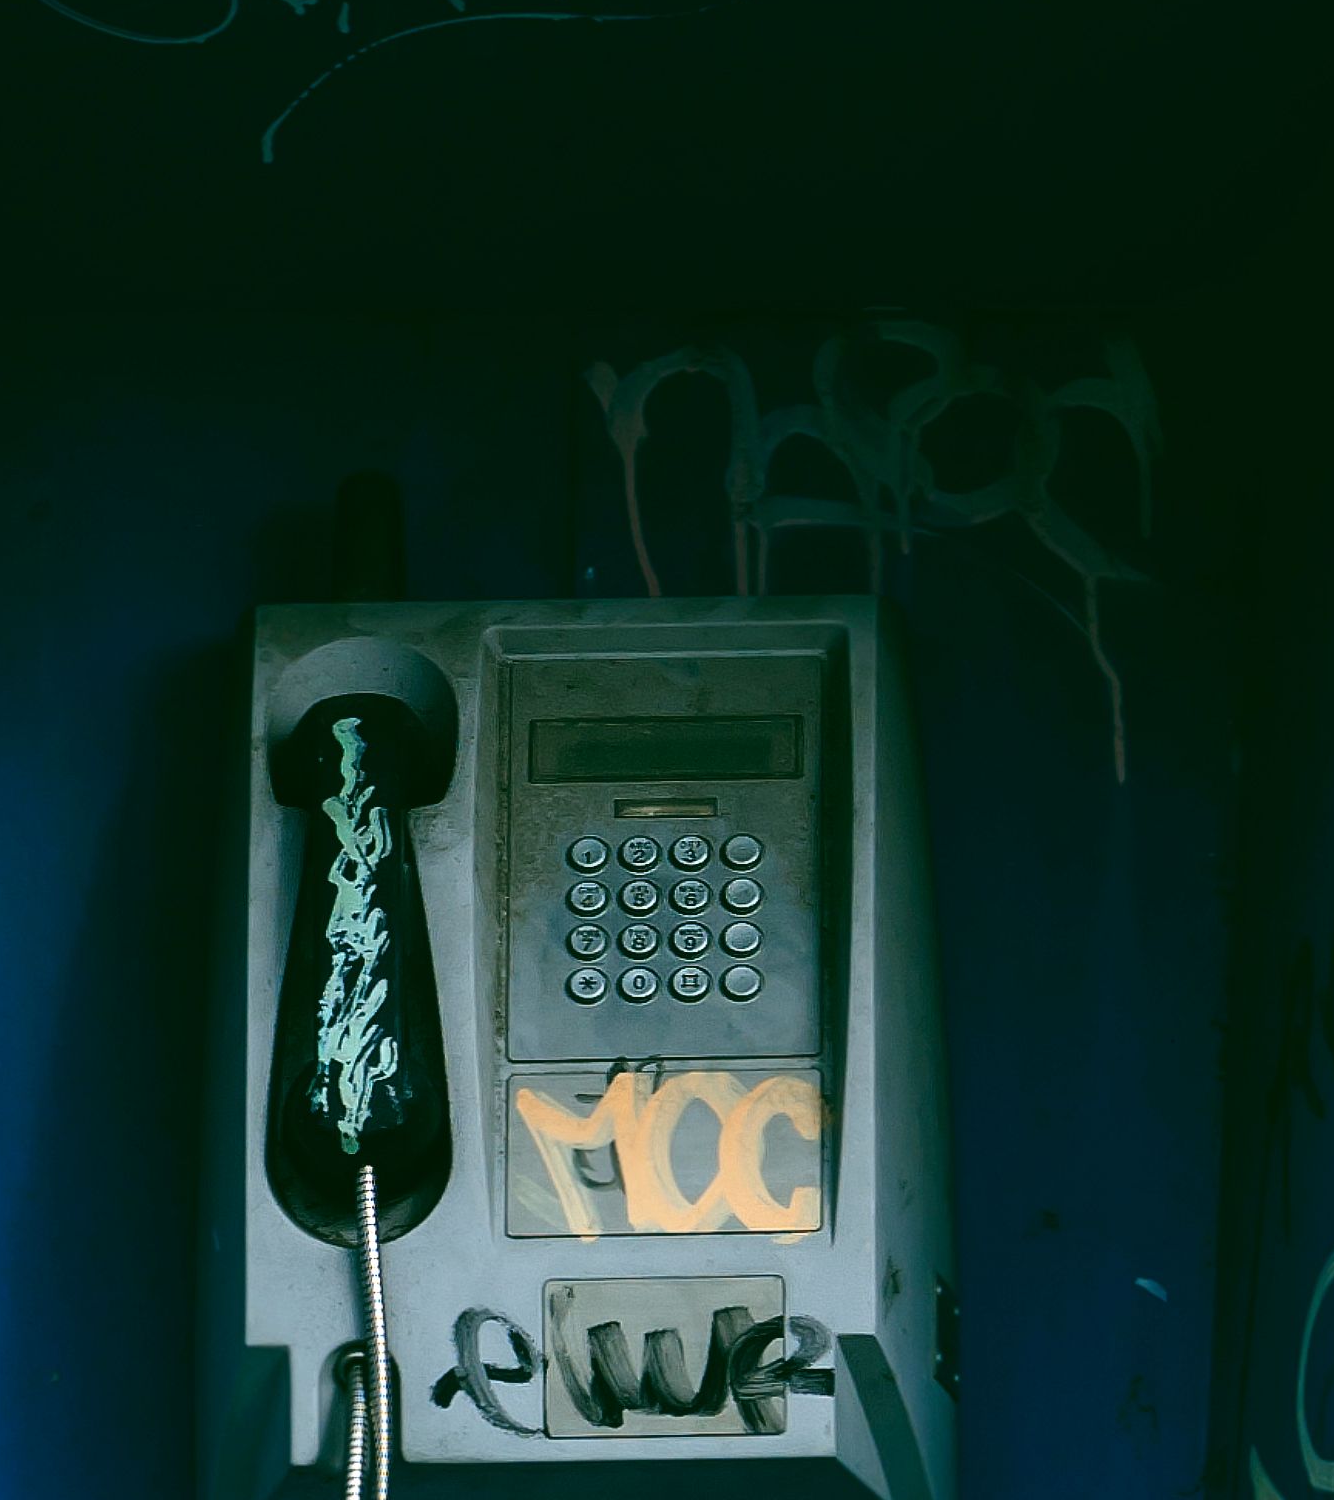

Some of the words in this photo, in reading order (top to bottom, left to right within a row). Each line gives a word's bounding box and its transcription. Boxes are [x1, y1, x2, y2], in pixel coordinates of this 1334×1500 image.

[632, 850, 646, 863] 2
[682, 848, 696, 861] 3
[633, 893, 646, 906] 5
[684, 893, 697, 906] 6
[632, 937, 646, 950] 8
[684, 937, 697, 950] 9
[633, 974, 645, 989] 0
